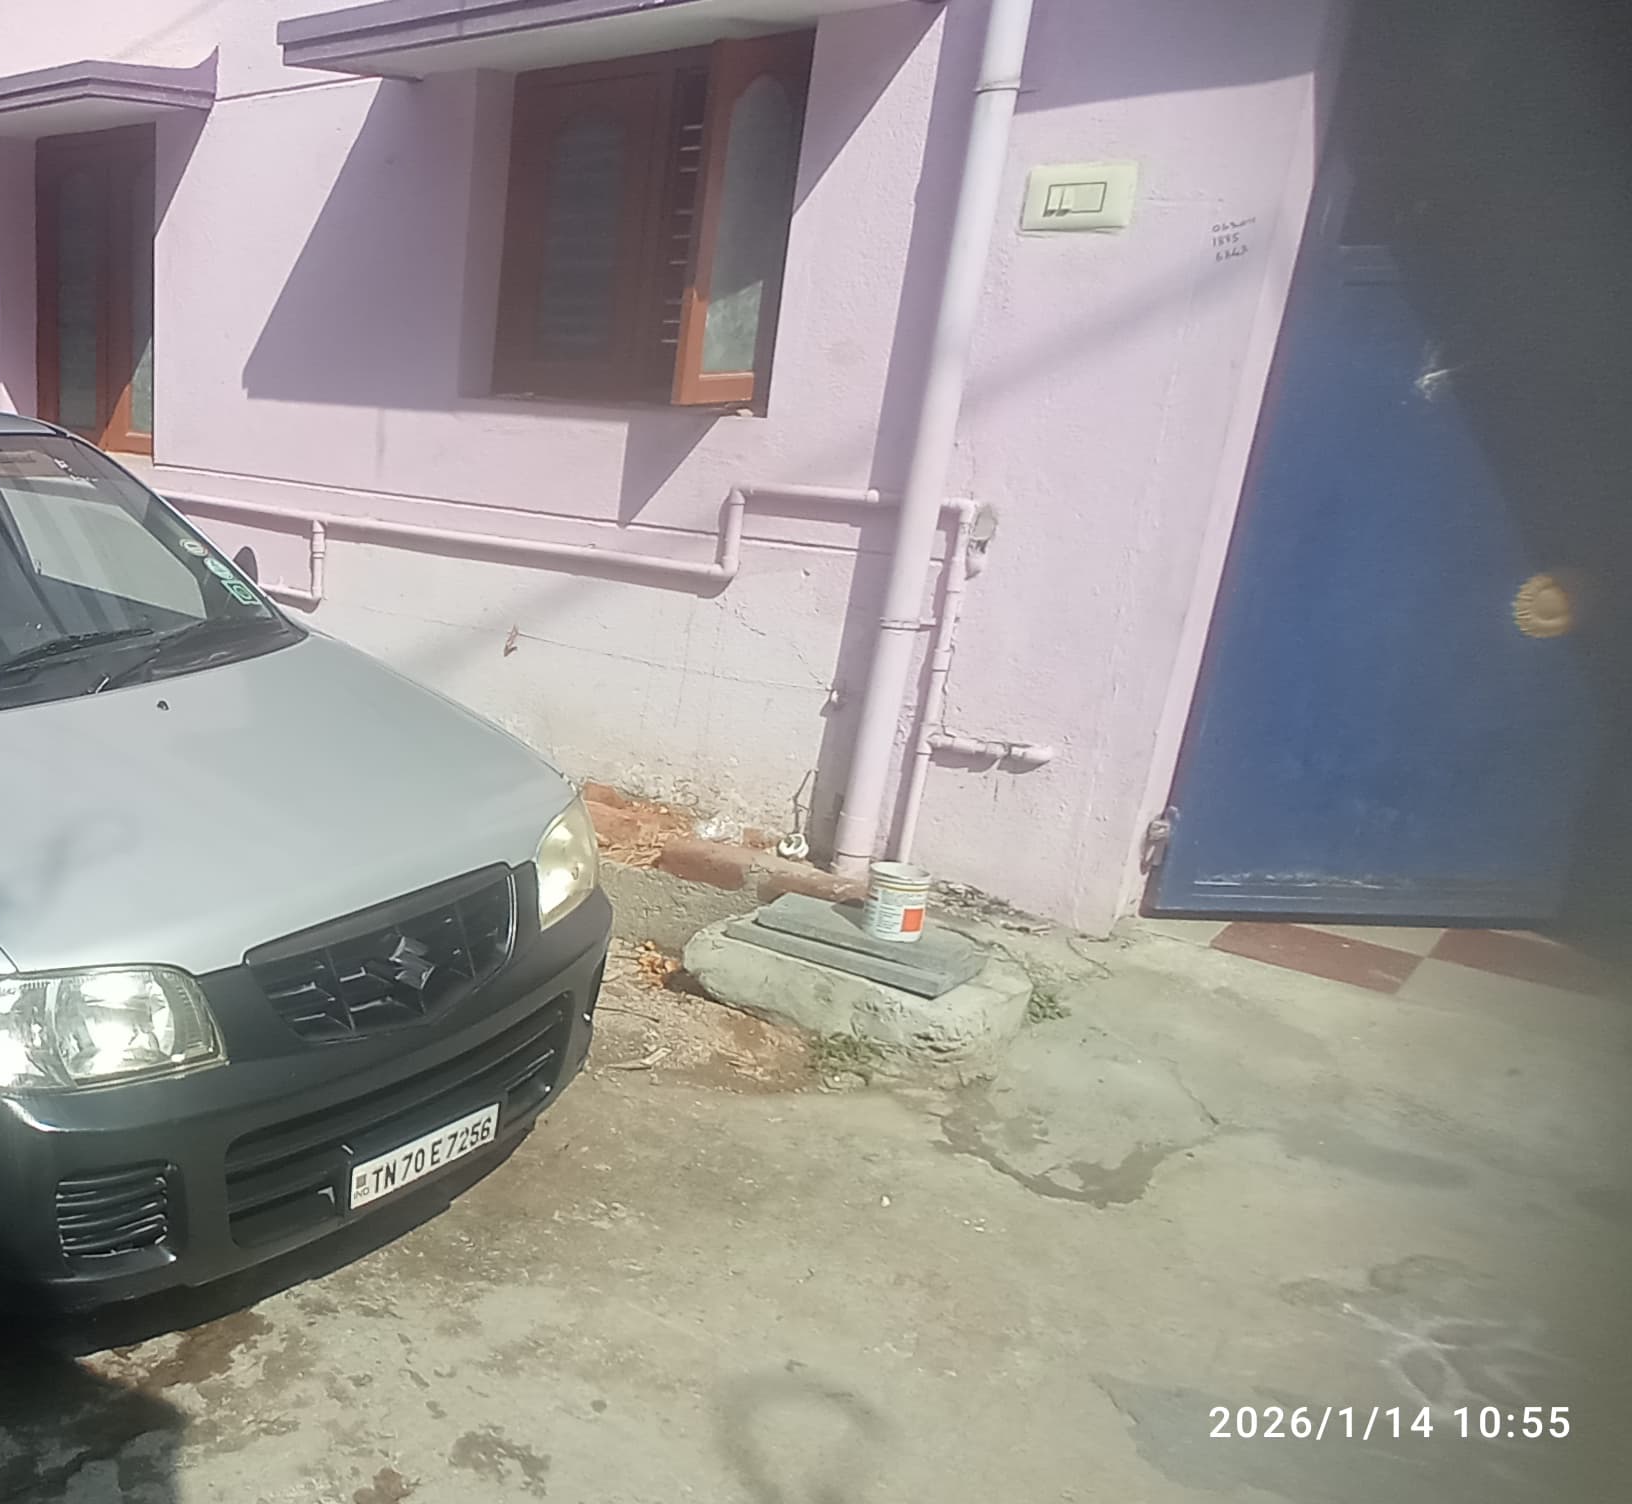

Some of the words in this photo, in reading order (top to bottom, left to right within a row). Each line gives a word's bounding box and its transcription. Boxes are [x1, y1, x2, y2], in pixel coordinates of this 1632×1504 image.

[372, 1159, 397, 1193] TN
[401, 1148, 425, 1181] 70
[430, 1138, 443, 1167] E
[446, 1116, 492, 1159] 7256
